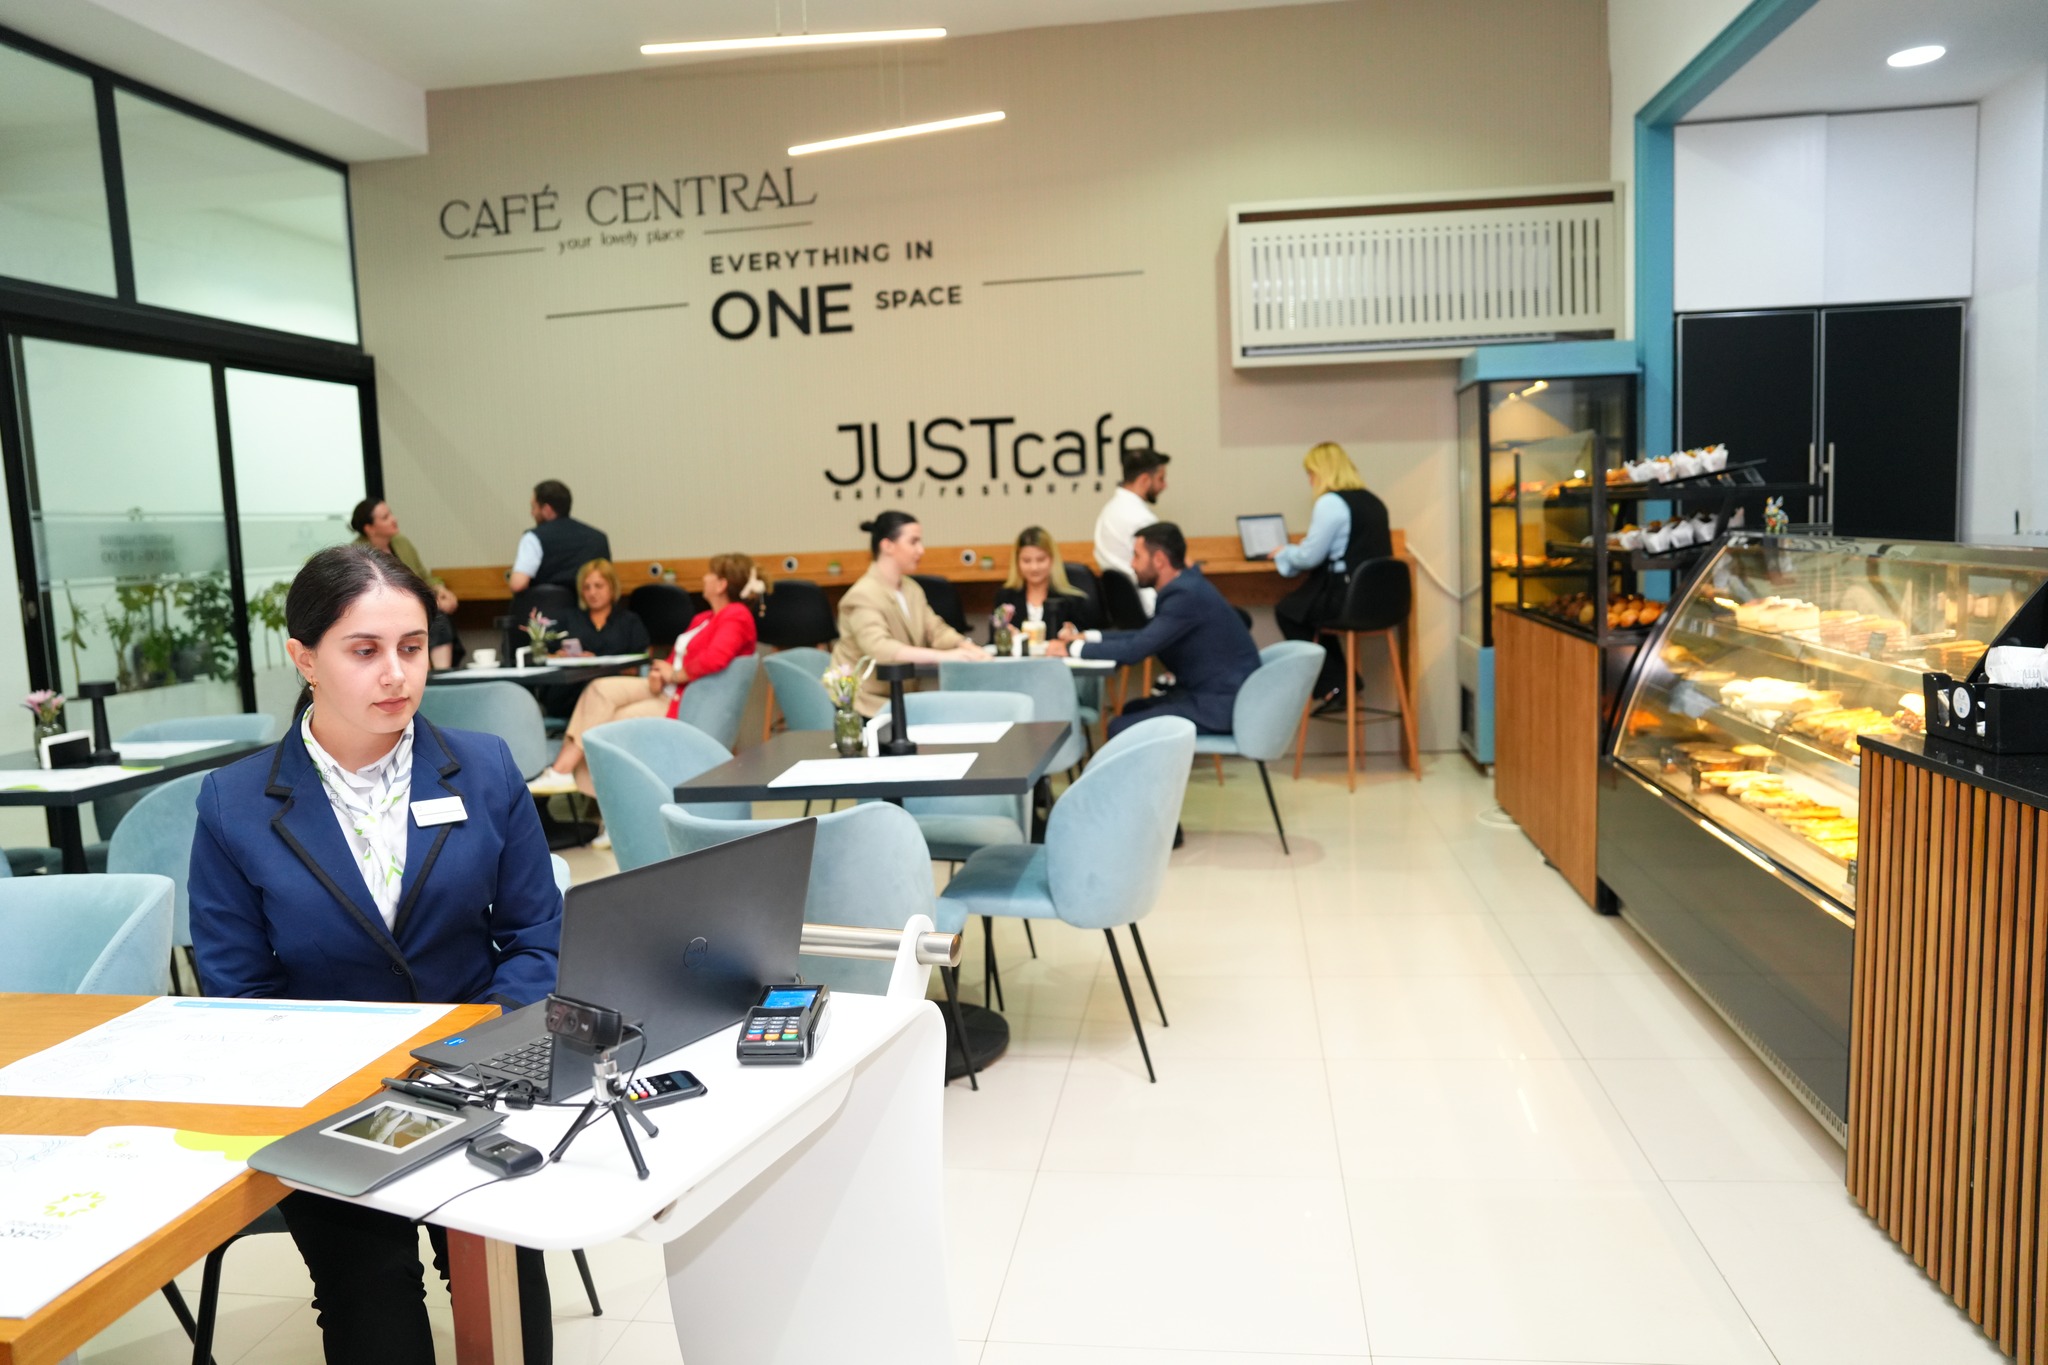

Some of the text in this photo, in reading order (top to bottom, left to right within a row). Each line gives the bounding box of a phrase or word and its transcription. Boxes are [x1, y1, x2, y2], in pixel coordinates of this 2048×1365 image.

[440, 167, 817, 240] CAFÉ CENTRAL
[558, 228, 684, 254] your lovely place
[710, 241, 934, 275] EVERYTHING IN
[711, 283, 963, 341] ONE SPACE
